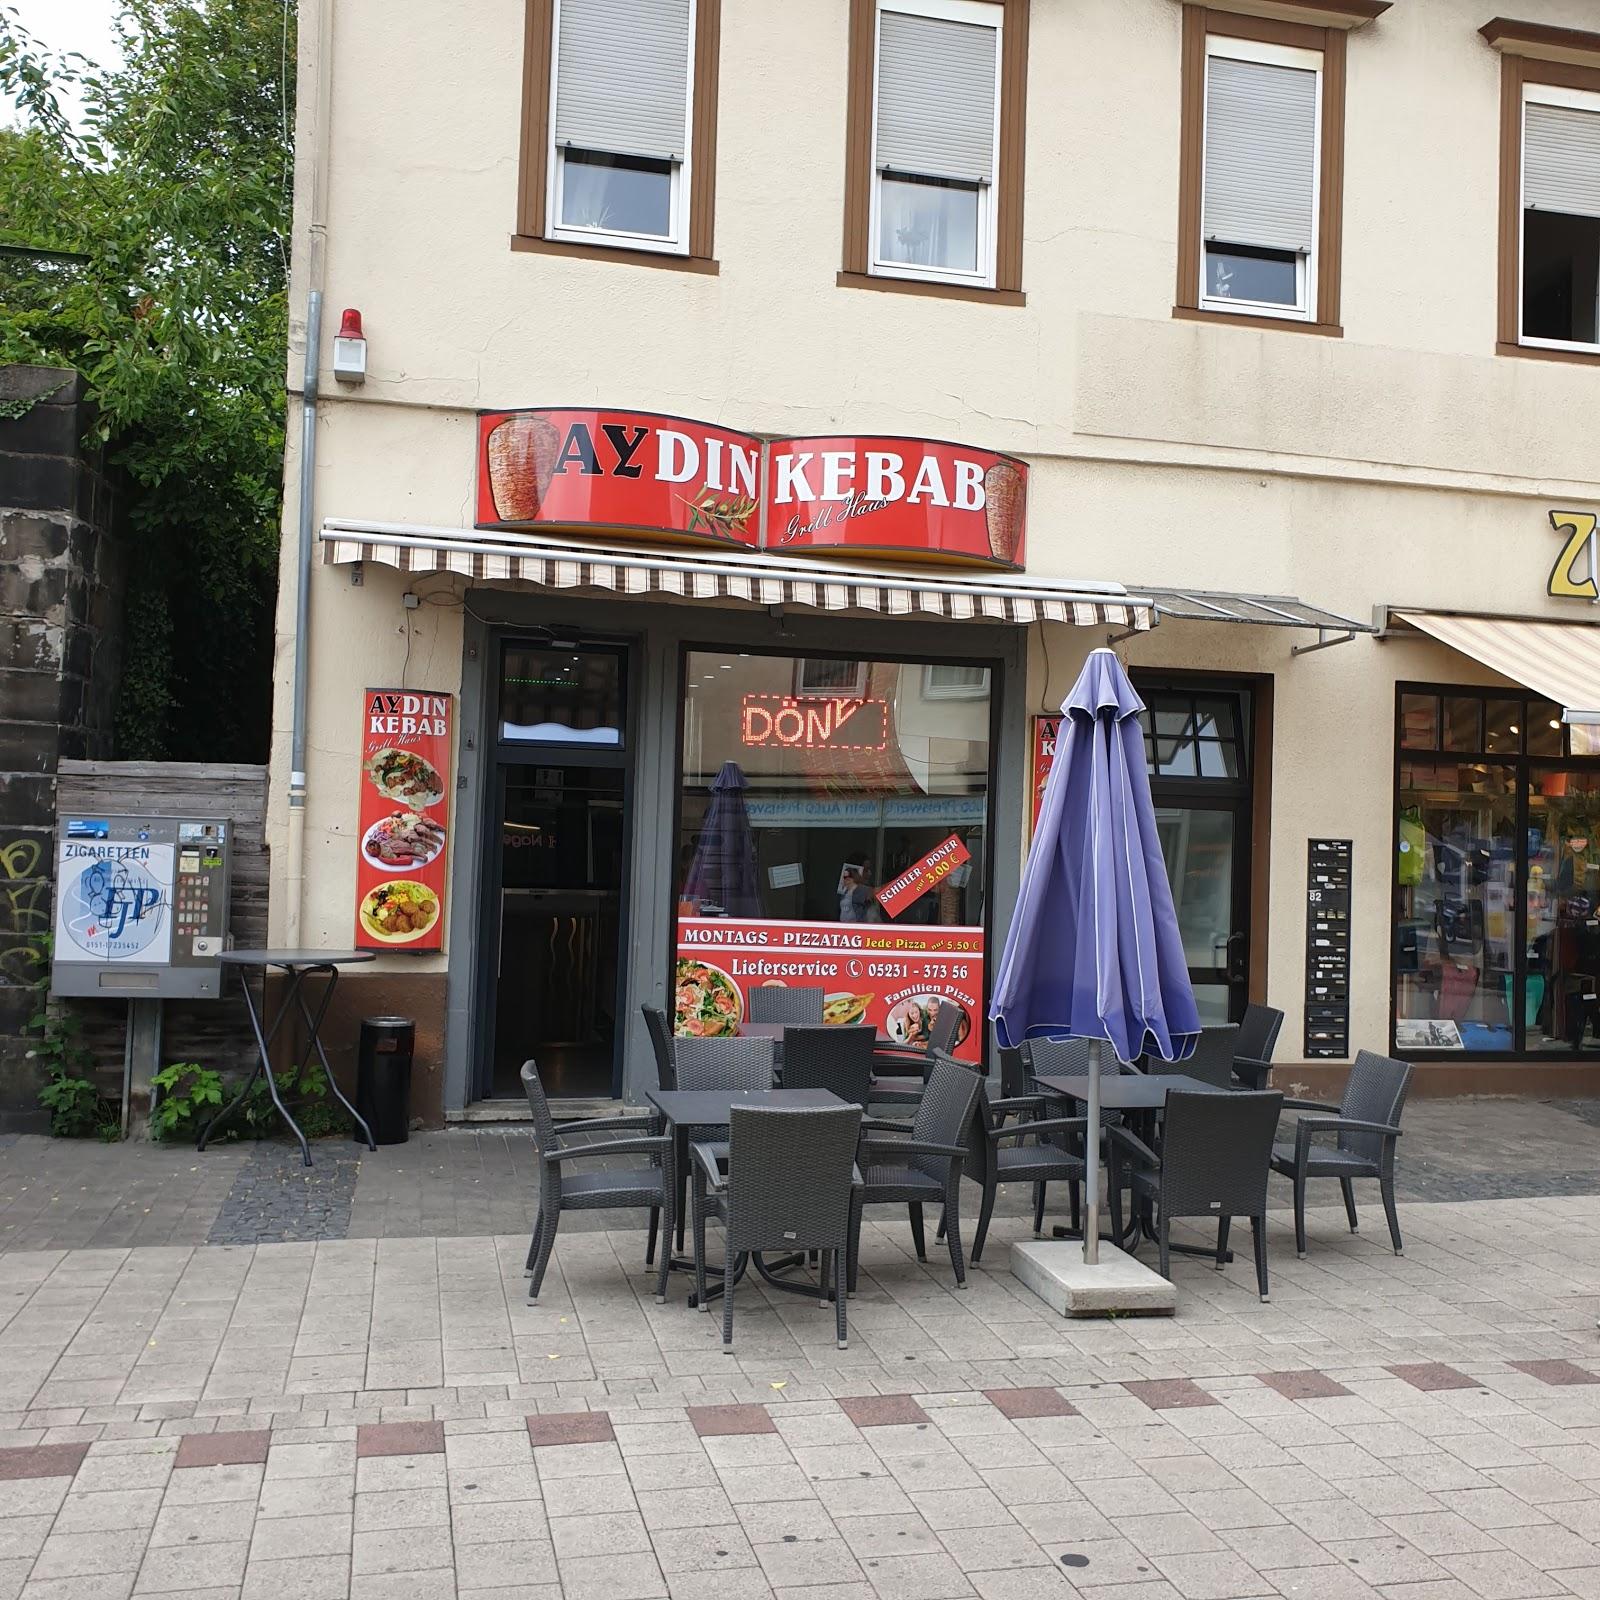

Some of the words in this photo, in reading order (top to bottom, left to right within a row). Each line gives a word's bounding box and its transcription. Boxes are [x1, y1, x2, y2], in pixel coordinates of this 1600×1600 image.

[552, 423, 758, 500] AYDIN
[774, 451, 987, 512] KEBAB
[780, 506, 832, 543] Grill
[836, 491, 892, 522] Haus
[369, 694, 447, 717] AYDIN
[370, 716, 447, 736] KEBAB
[65, 845, 150, 859] ZIGARETTEN
[880, 867, 923, 903] SCHÜLER
[926, 839, 959, 868] DÖNER
[916, 878, 925, 892] nur
[949, 852, 960, 864] €
[1309, 892, 1322, 902] 82
[684, 929, 768, 945] MONTAGS
[783, 932, 862, 948] PIZZATAG
[865, 938, 892, 949] Jede
[896, 939, 926, 950] Pizza
[931, 939, 945, 950] nur
[732, 959, 838, 977] Lieferservice
[868, 963, 909, 979] 05231
[923, 965, 948, 979] 373
[952, 965, 968, 979] 56
[884, 984, 941, 1005] Familien
[944, 984, 976, 1007] Pizza
